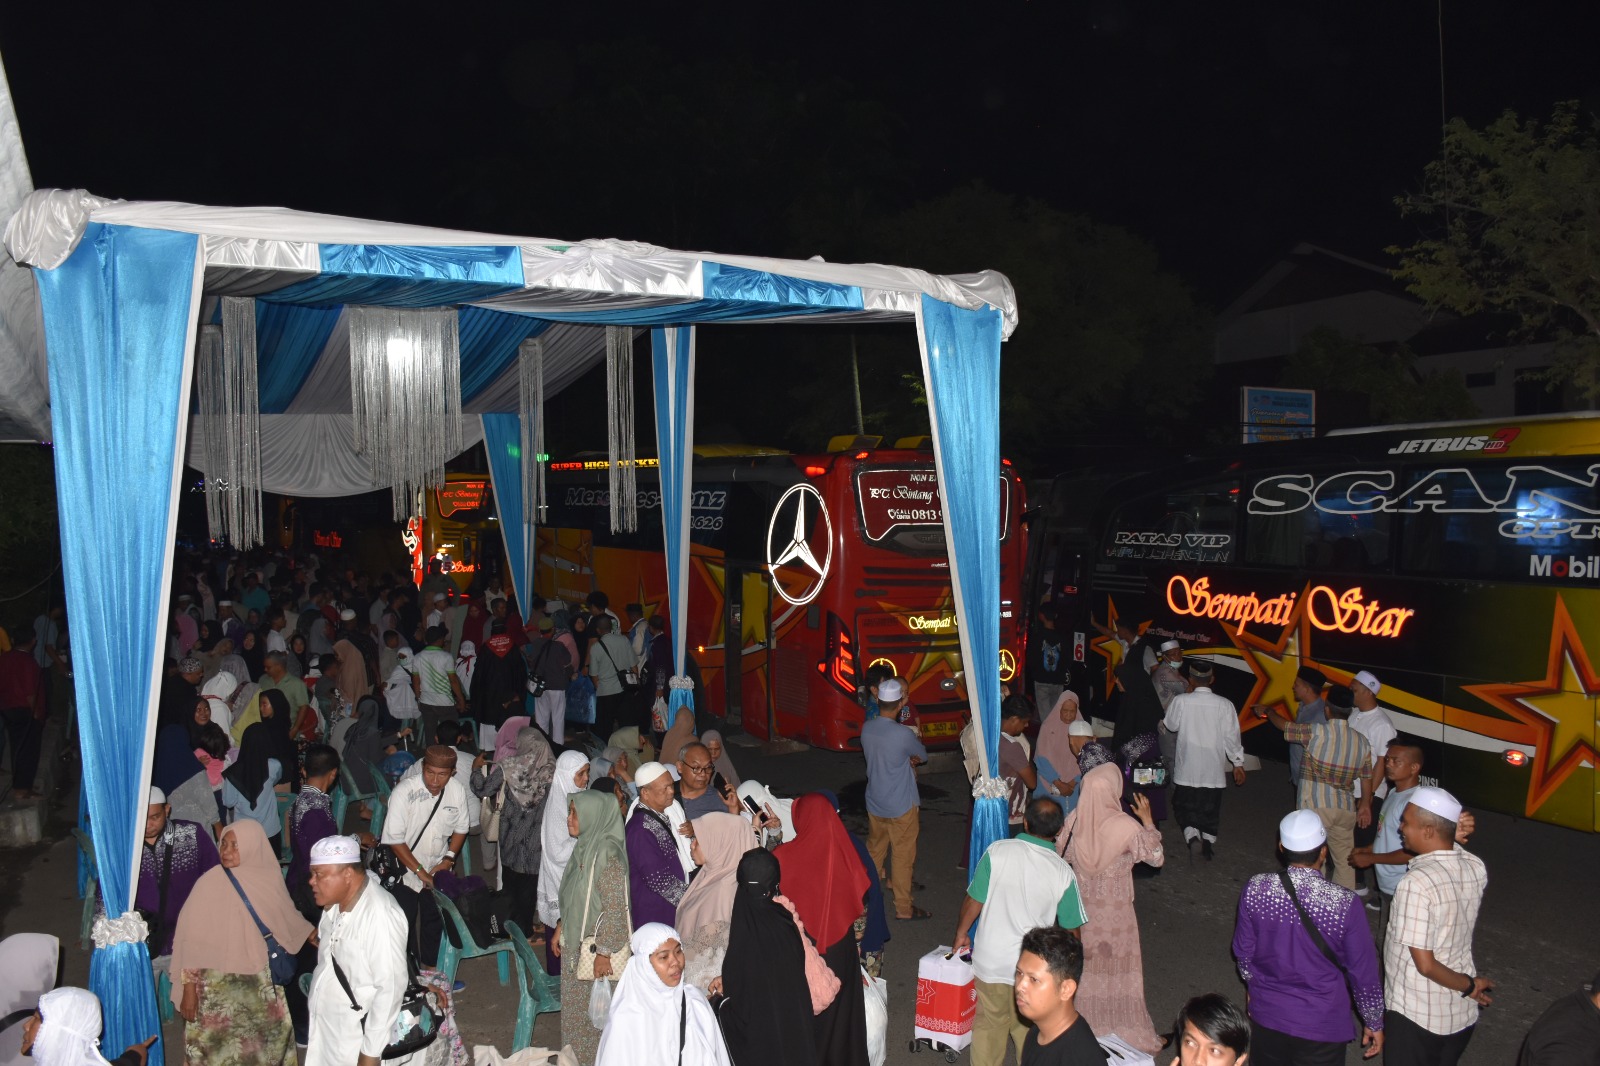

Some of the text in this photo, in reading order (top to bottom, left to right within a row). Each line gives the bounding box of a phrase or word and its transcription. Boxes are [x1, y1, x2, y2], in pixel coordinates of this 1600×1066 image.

[1387, 436, 1489, 455] JETBUS
[550, 461, 583, 471] SUPER
[892, 485, 934, 505] Bintang
[912, 509, 937, 520] 0813
[1115, 531, 1231, 548] PATAS VIP
[1529, 554, 1600, 579] Mobil
[1166, 574, 1415, 638] Sempati Star
[908, 615, 951, 633] Sempati
[1074, 643, 1083, 661] 6
